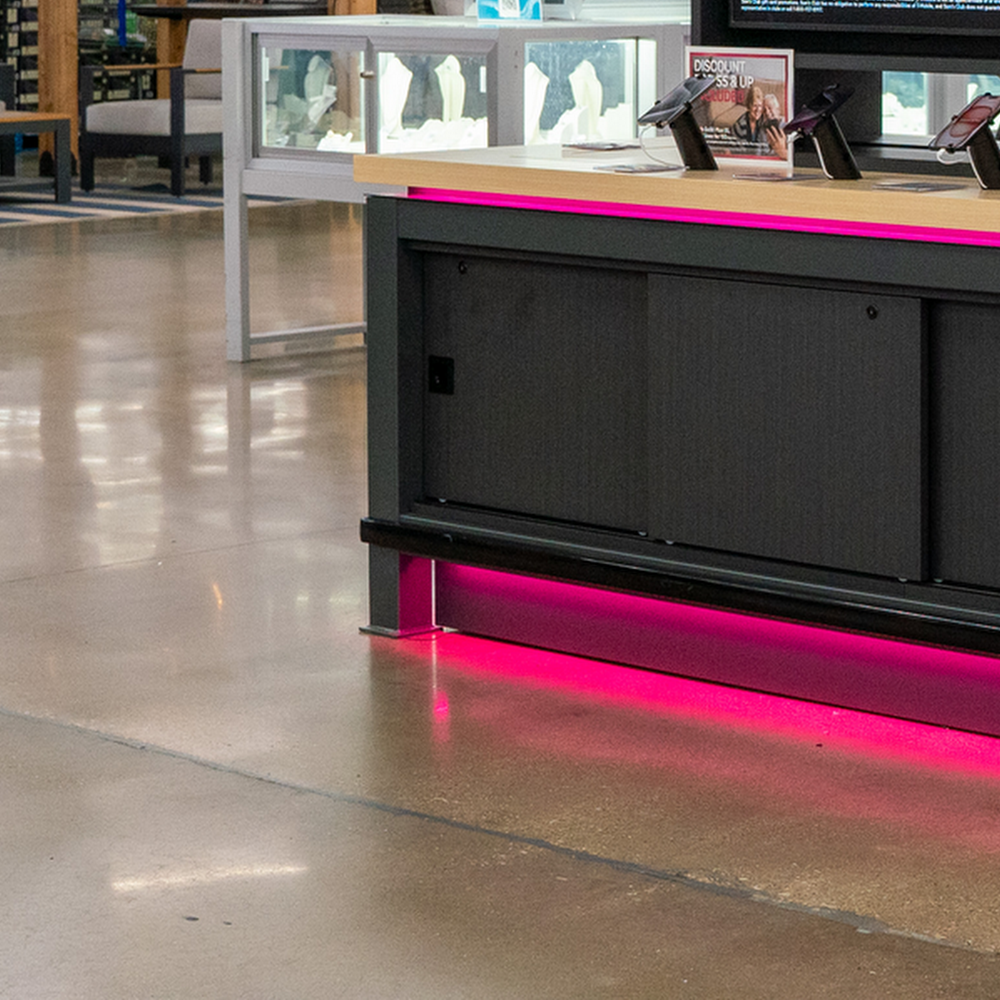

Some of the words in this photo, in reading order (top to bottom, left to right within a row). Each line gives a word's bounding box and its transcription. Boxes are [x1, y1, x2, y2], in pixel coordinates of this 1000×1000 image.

[694, 59, 746, 75] DISCOUNT
[739, 76, 754, 90] UP
[701, 89, 745, 103] CLUDED
